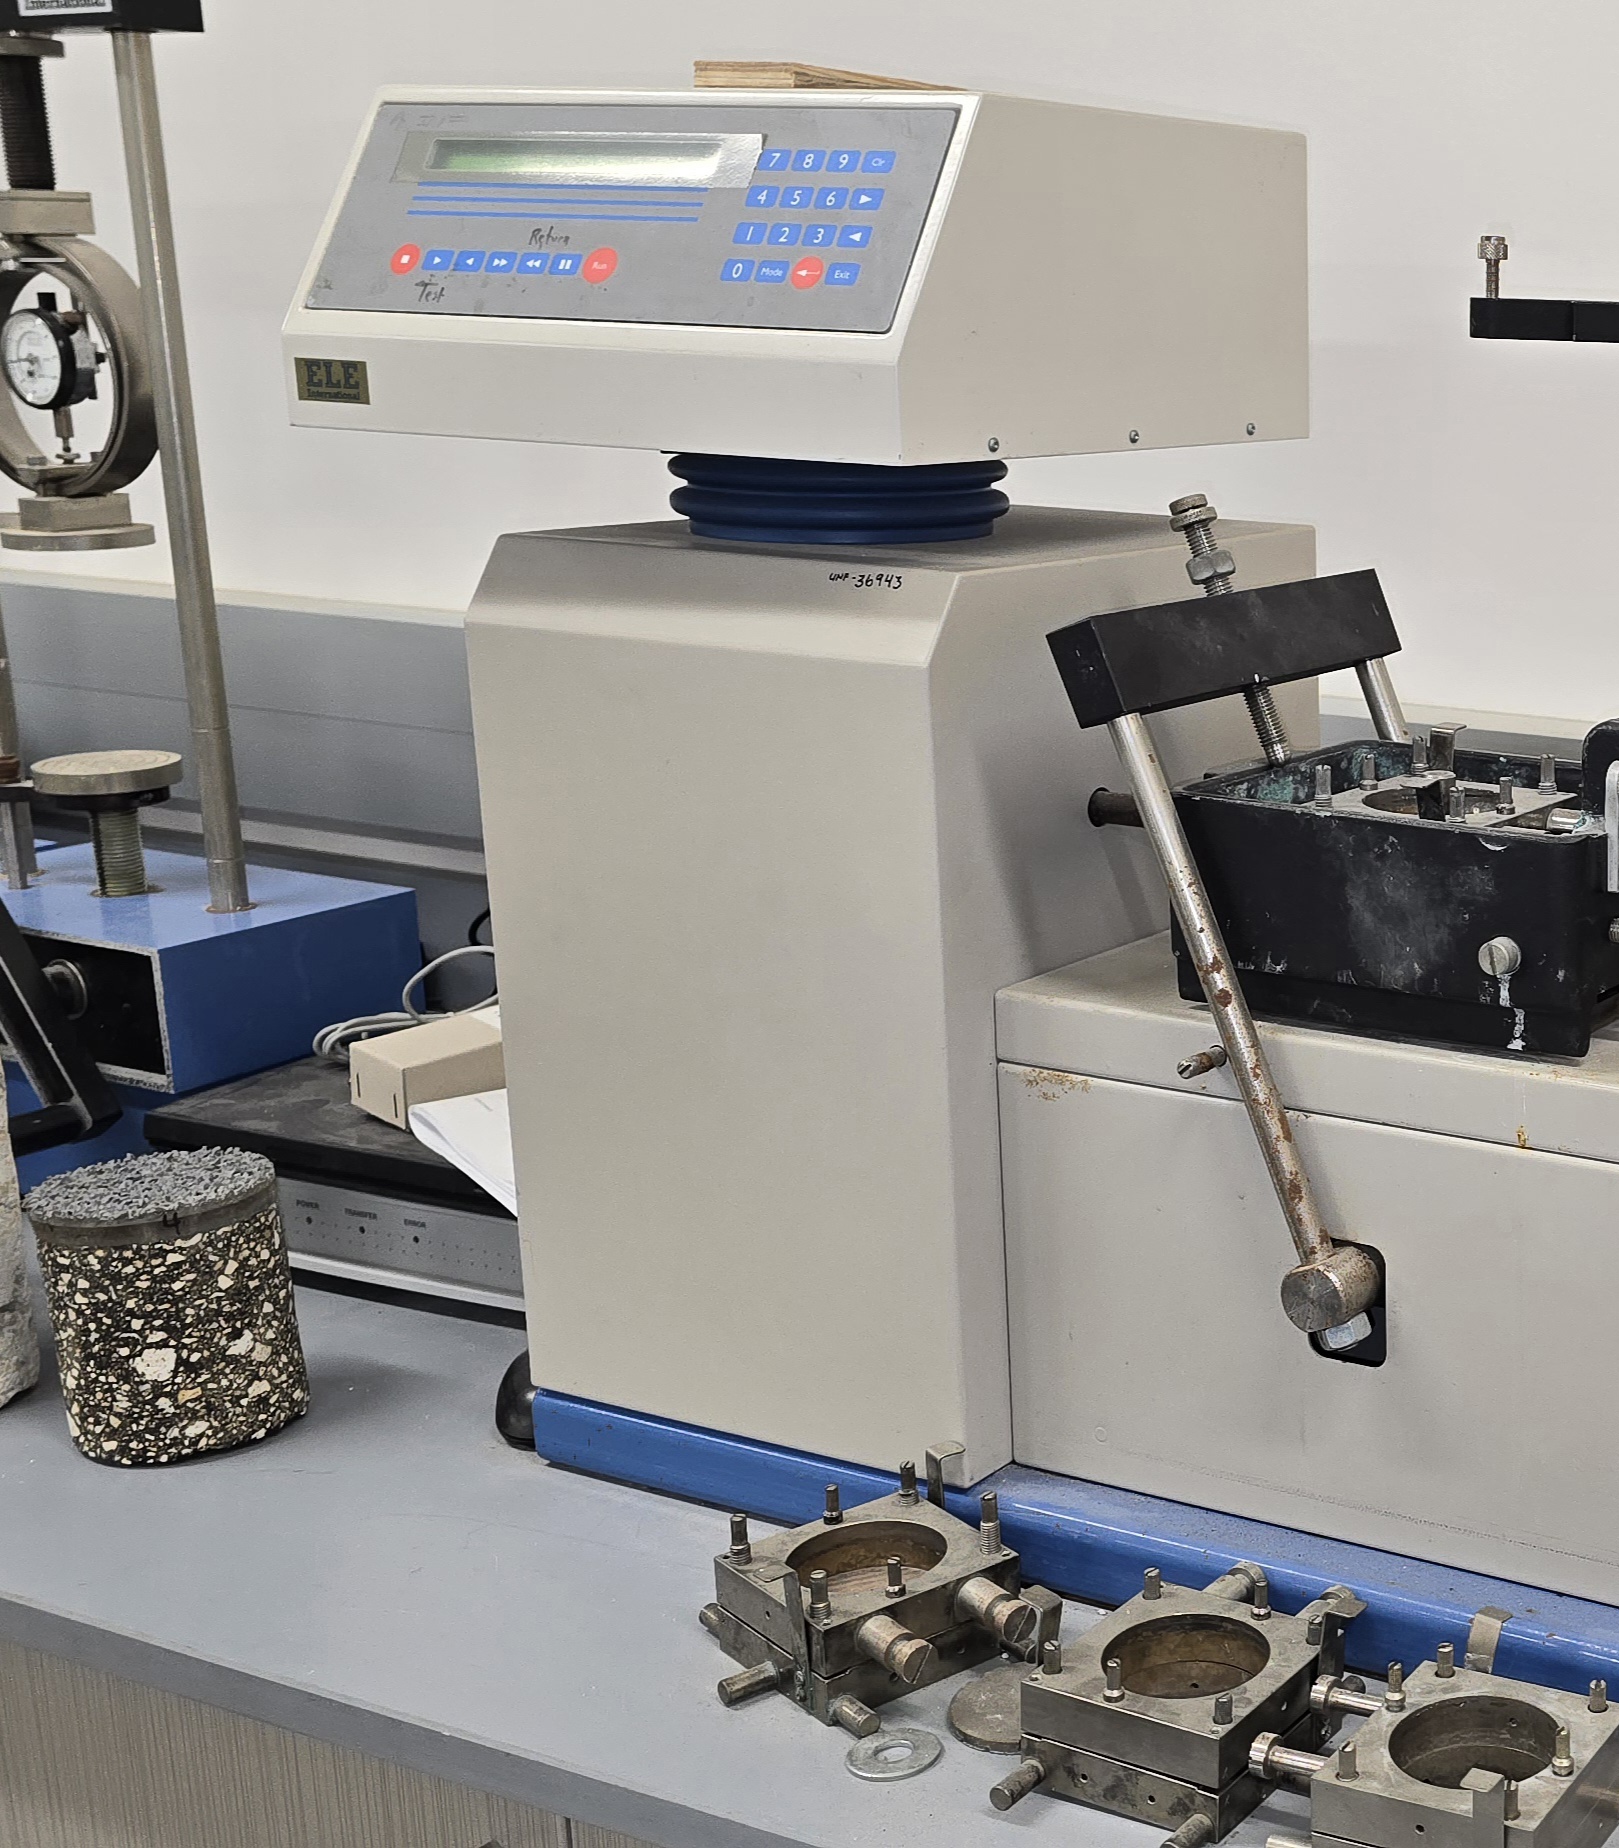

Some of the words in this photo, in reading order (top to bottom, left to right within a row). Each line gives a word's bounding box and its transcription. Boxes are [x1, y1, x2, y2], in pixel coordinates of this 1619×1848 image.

[769, 152, 781, 168] 7
[803, 153, 814, 169] 8
[838, 153, 849, 169] 9
[757, 189, 768, 204] 4
[790, 190, 802, 205] 5
[826, 191, 836, 206] 6
[746, 226, 754, 241] 1
[779, 227, 790, 242] 2
[813, 228, 824, 243] 3
[732, 263, 743, 278] 0
[760, 267, 783, 277] Mode
[834, 270, 850, 280] Exit
[415, 281, 446, 302] Test
[305, 361, 360, 389] ELE
[307, 389, 360, 400] International
